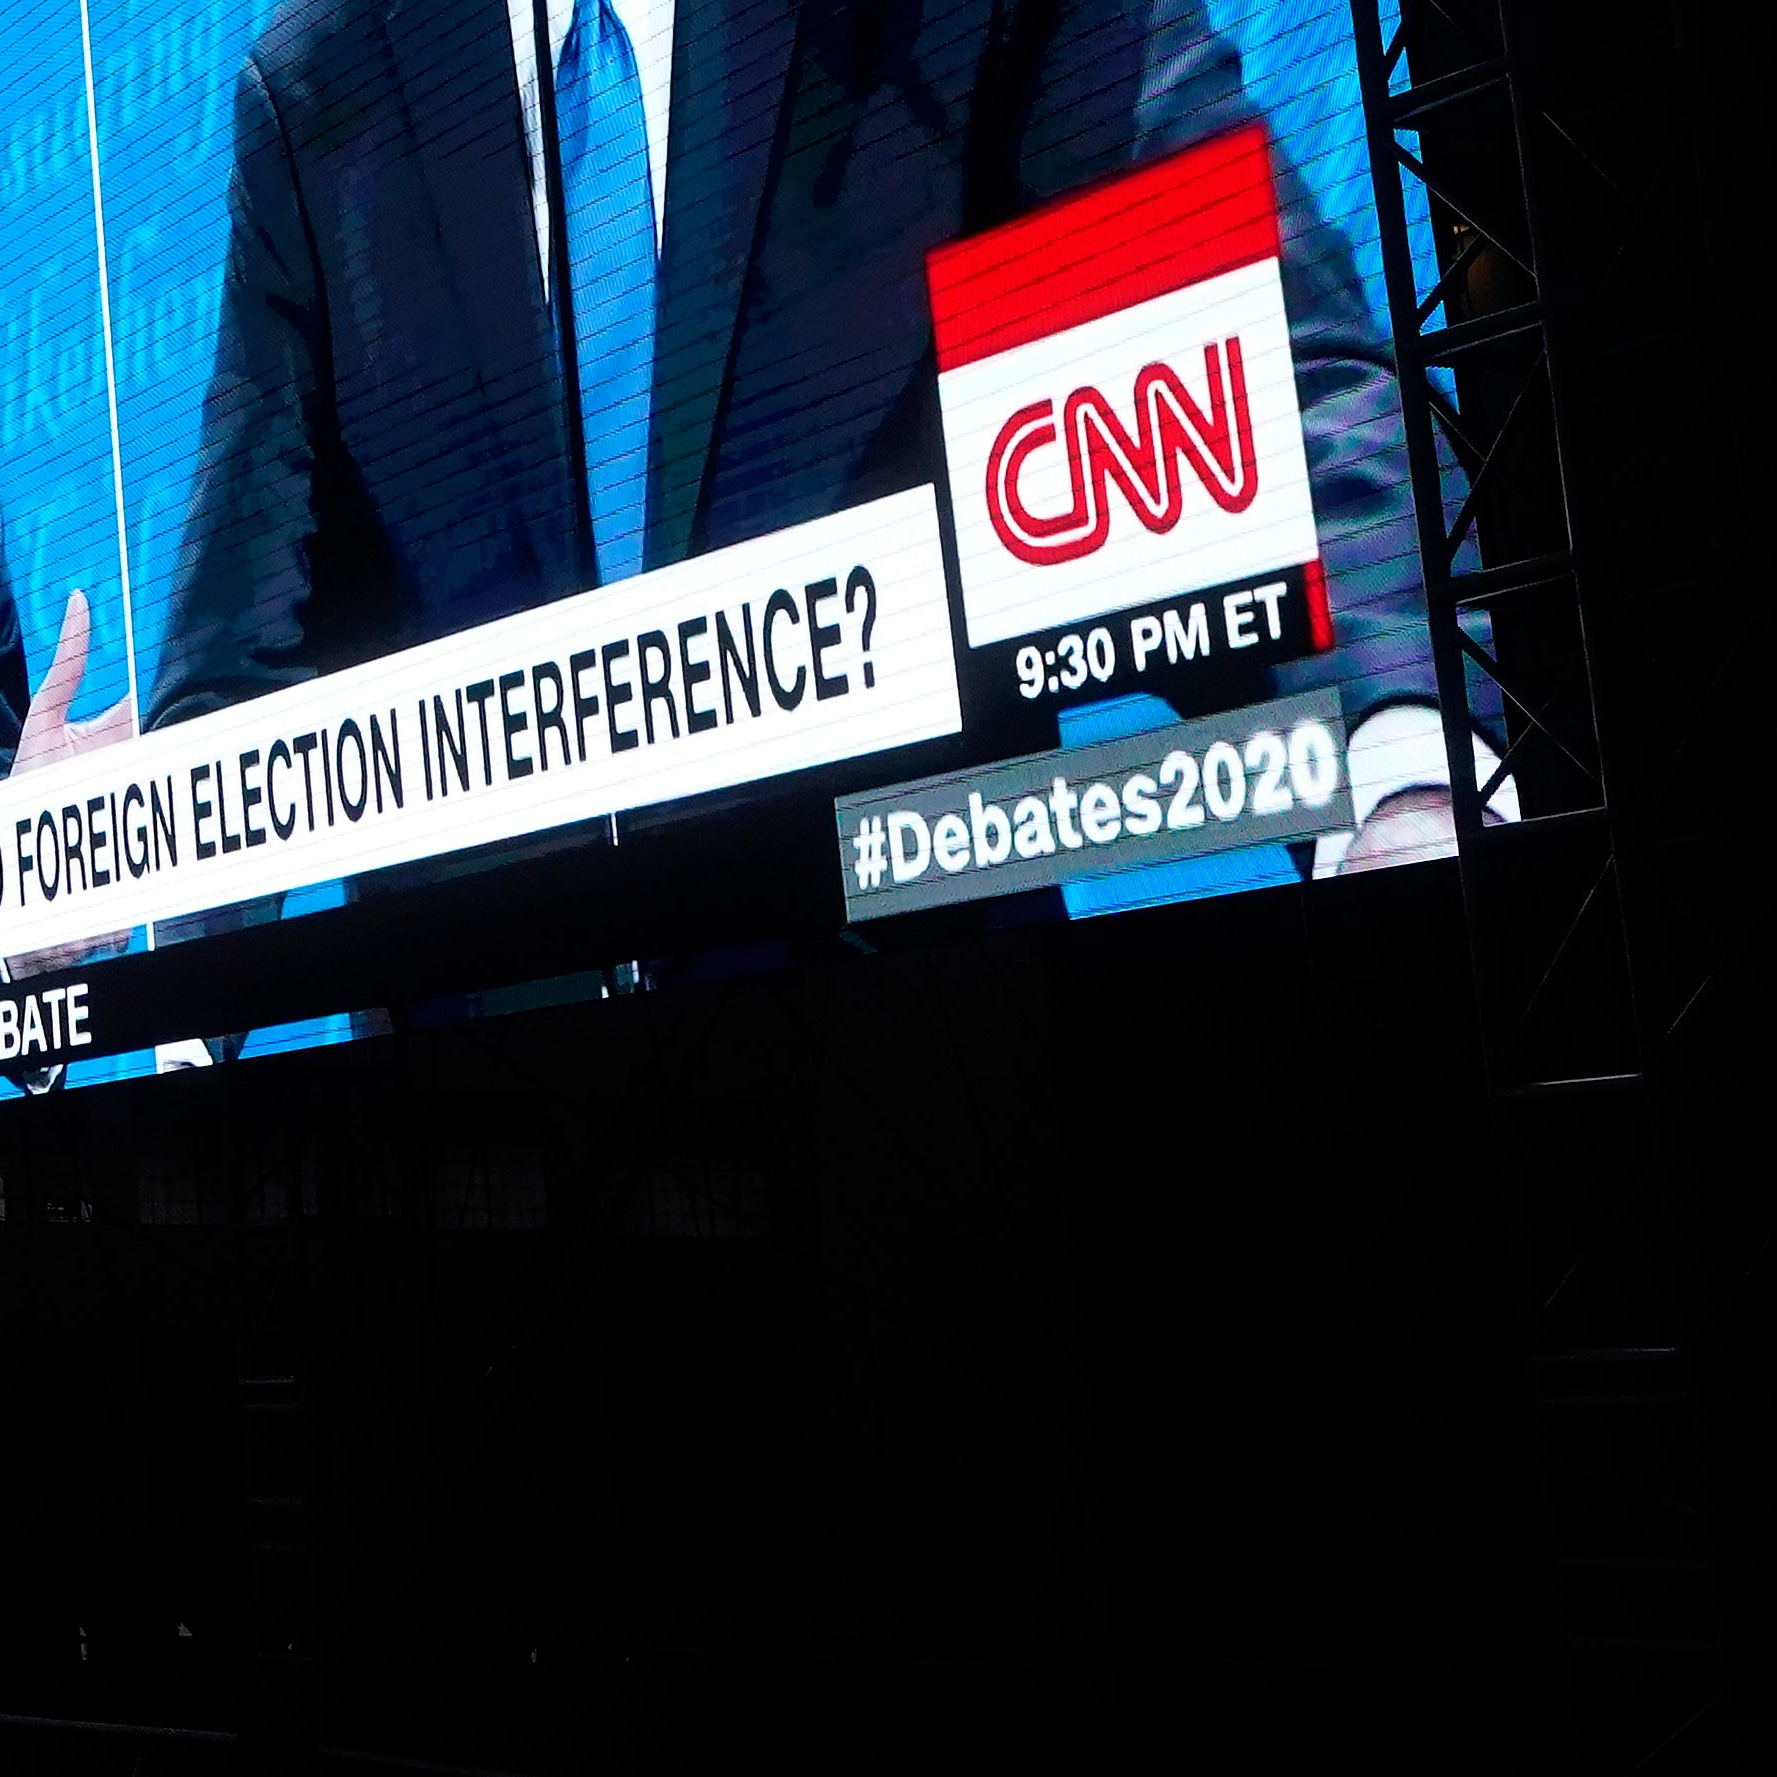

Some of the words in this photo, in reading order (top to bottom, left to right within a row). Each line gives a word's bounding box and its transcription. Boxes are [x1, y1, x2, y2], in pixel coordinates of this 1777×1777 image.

[986, 337, 1258, 566] CNN
[15, 775, 178, 907] FOREIGN
[190, 708, 404, 861] ELECTION
[418, 565, 878, 801] INTERFERENCE?
[1016, 627, 1116, 699] 9:30
[1130, 603, 1211, 672] PM
[1223, 581, 1288, 649] ET
[853, 719, 1338, 890] #Debates2020
